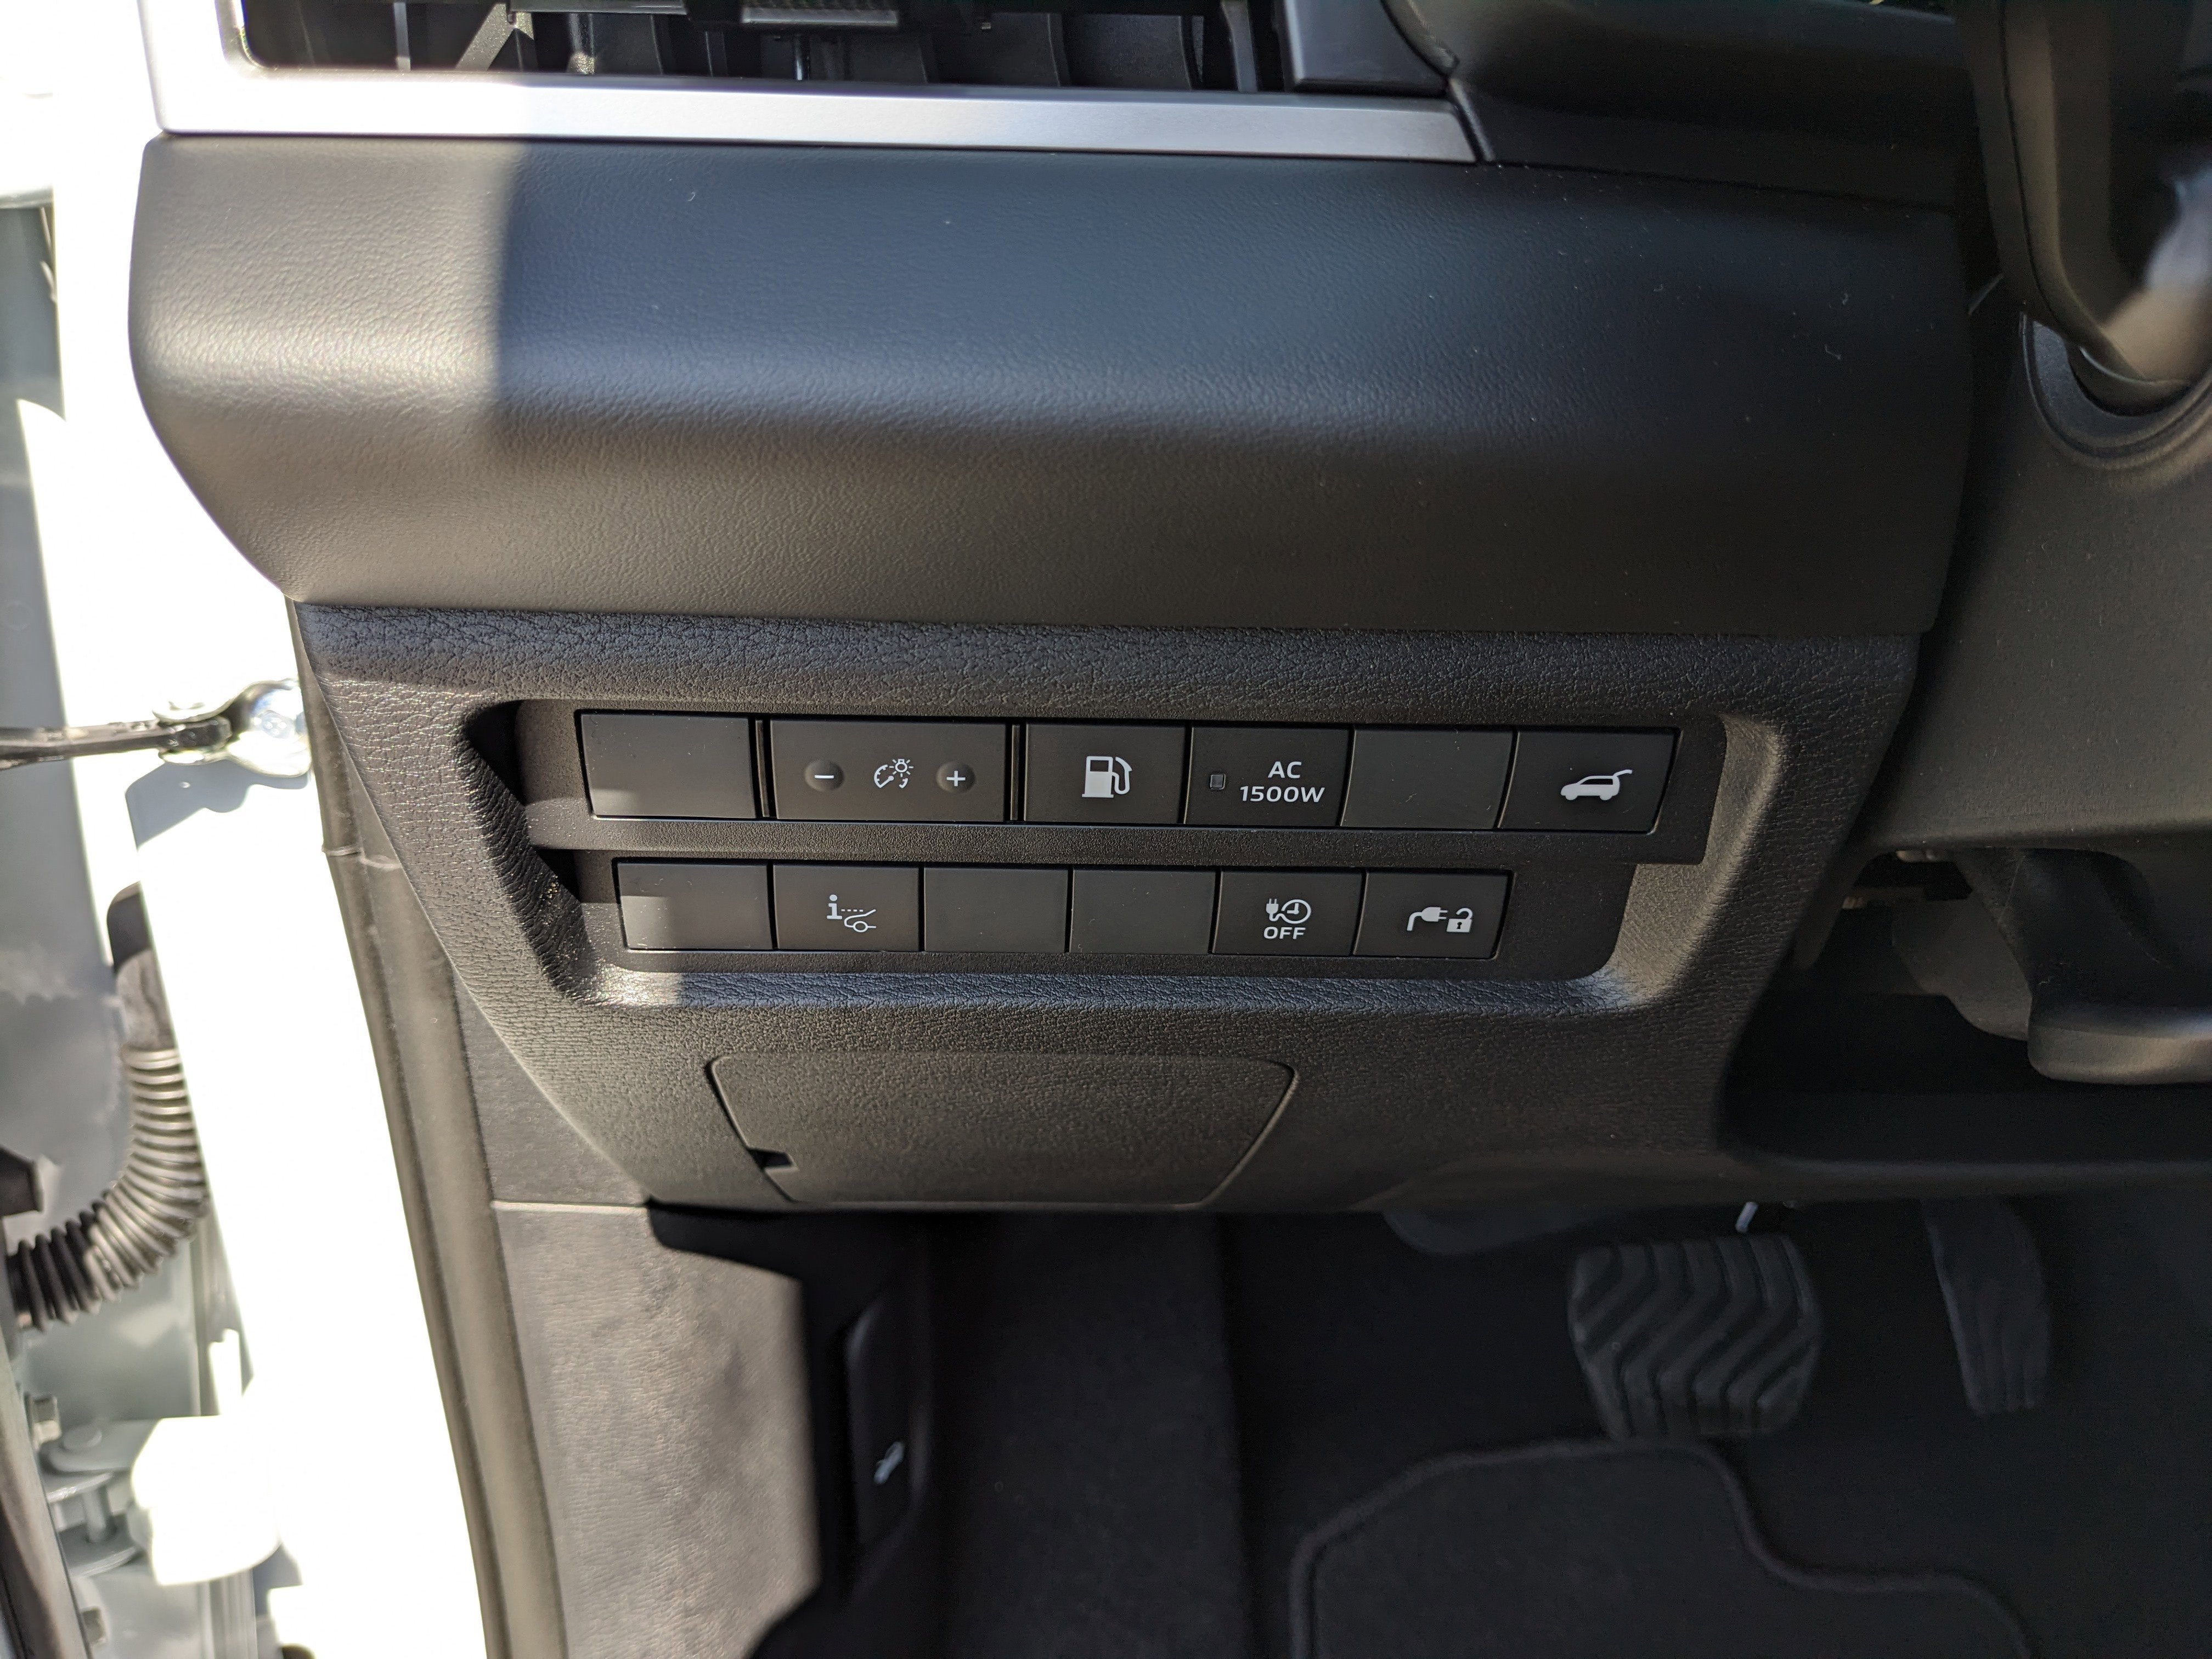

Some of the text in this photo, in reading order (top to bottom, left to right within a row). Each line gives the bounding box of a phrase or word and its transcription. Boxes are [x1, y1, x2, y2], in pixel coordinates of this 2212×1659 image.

[1267, 761, 1302, 779] AC
[1239, 786, 1325, 803] 1500W
[1263, 926, 1306, 939] OFF
